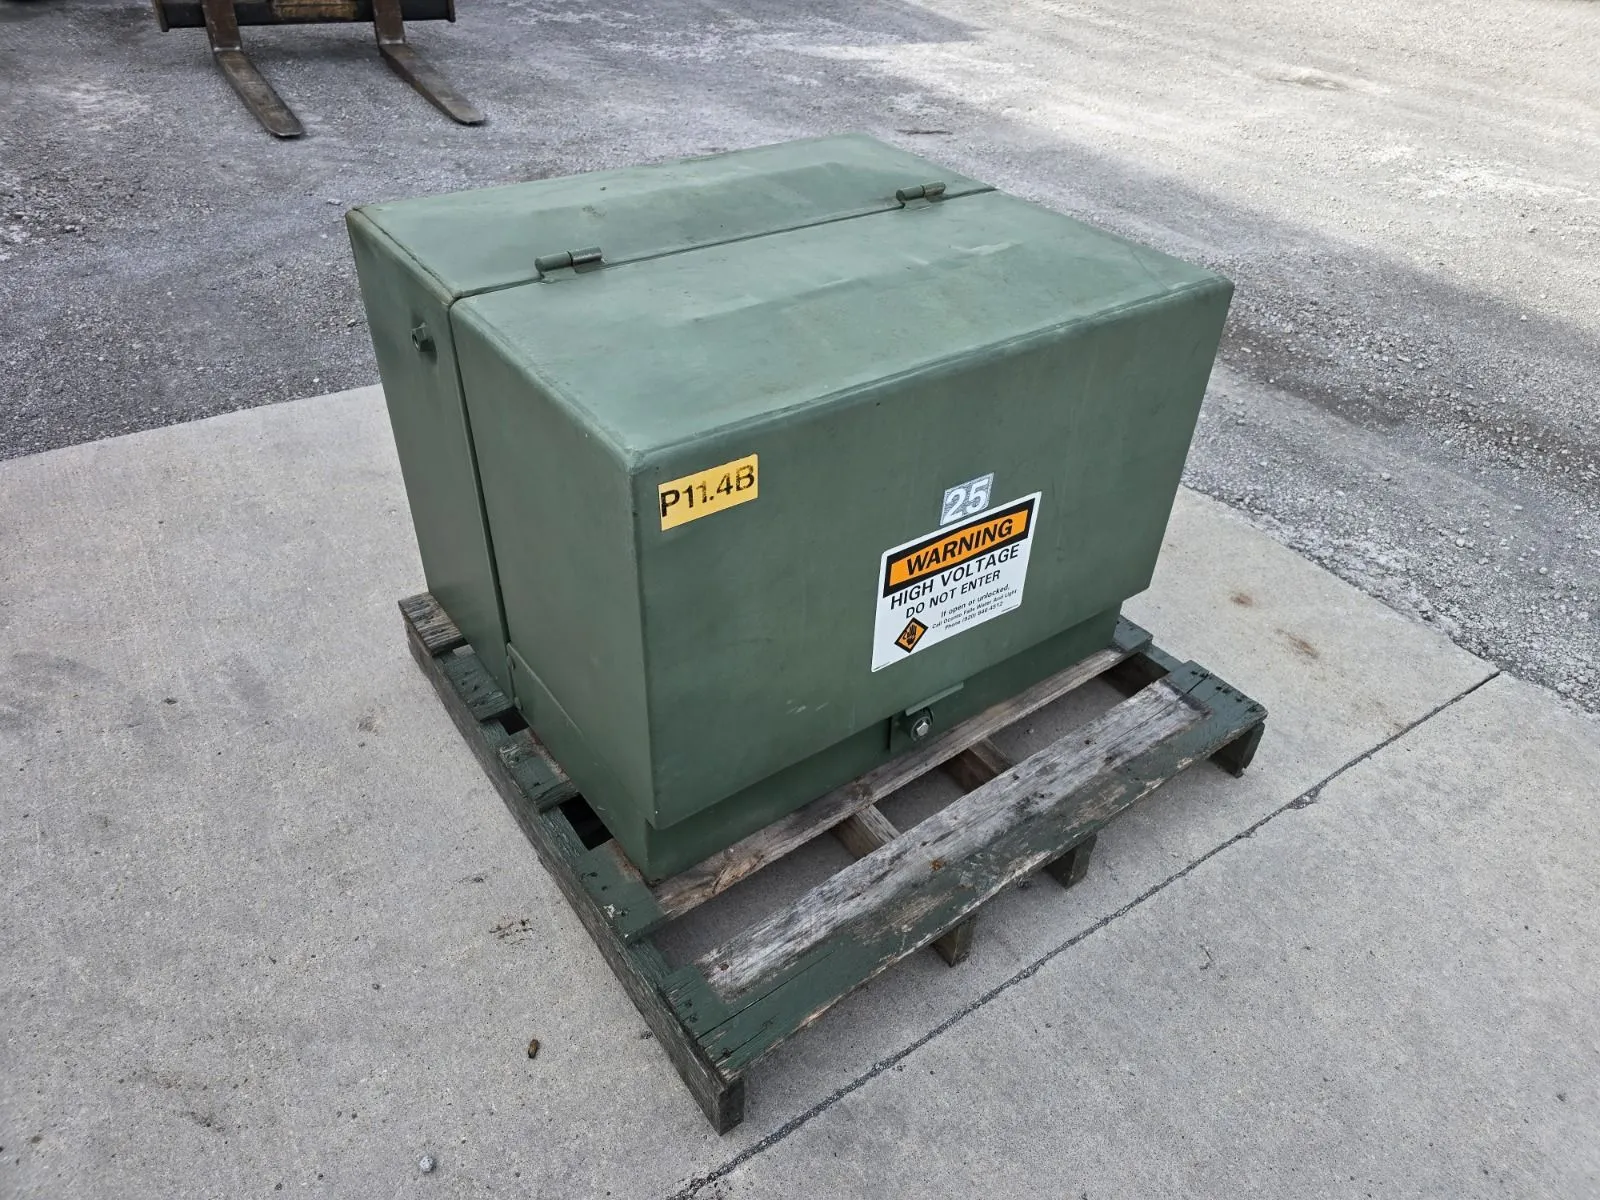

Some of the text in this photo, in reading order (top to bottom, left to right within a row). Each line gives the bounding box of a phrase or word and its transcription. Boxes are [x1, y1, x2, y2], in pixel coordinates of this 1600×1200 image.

[661, 464, 755, 517] P11.4B
[943, 478, 989, 520] 25
[907, 518, 1013, 575] WARNING
[890, 544, 1020, 610] HIGH VOLTAGE
[906, 570, 1001, 619] DO NOT ENTER
[949, 604, 966, 615] open
[977, 584, 1010, 602] unlocked,
